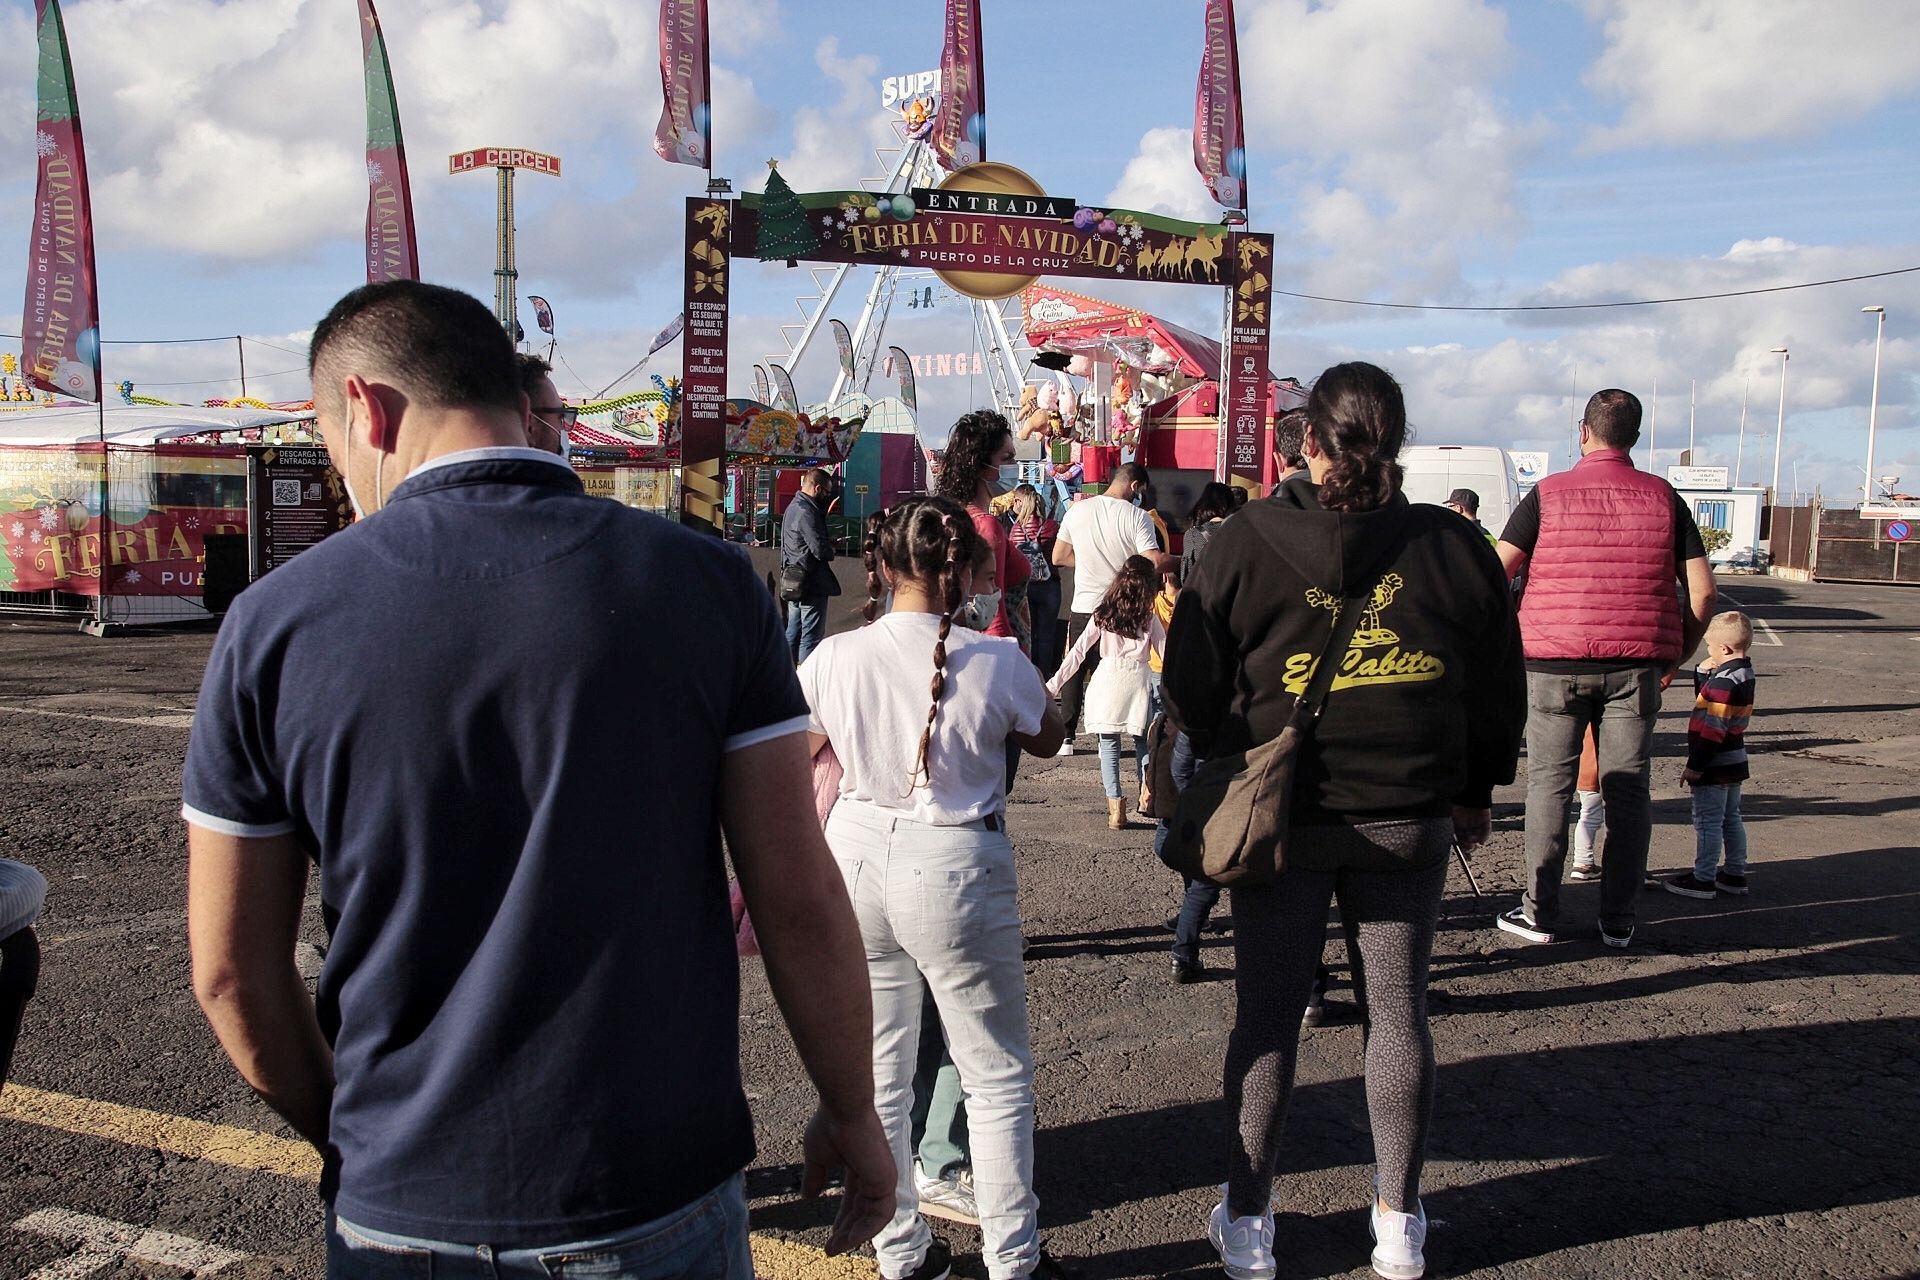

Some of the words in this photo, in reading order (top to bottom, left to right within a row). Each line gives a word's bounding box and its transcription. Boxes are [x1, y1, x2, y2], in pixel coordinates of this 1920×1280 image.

[451, 152, 475, 172] LA
[486, 149, 558, 174] CARCEL
[928, 194, 1057, 216] ENTRADA
[842, 221, 939, 255] FERIA
[949, 222, 987, 246] DE
[998, 224, 1124, 269] NAVIDAD
[919, 250, 977, 263] PUERTO
[983, 253, 1001, 265] DE
[1008, 255, 1026, 266] LA
[1032, 257, 1070, 269] CRUZ
[690, 302, 703, 311] ESTE
[703, 302, 726, 312] ESPACIO
[693, 310, 701, 319] ES
[701, 311, 722, 320] SEGURO
[690, 319, 704, 328] PARA
[705, 320, 716, 329] QUE
[717, 320, 724, 329] TE
[693, 328, 721, 337] DIVIERTAS
[1233, 327, 1244, 335] POR
[1244, 327, 1250, 335] LA
[1250, 328, 1266, 336] SALUD
[1233, 335, 1240, 343] DE
[703, 357, 711, 365] DE
[882, 352, 983, 378] VKINGA
[693, 385, 719, 394] ESPACIOS
[692, 402, 700, 410] DE
[700, 402, 719, 411] FORMA
[692, 410, 719, 419] CONTINUA
[279, 450, 317, 458] DESCARGA
[279, 458, 317, 466] ENTRADAS
[318, 458, 332, 466] AQU
[265, 468, 271, 477] 1
[588, 480, 597, 489] LA
[265, 511, 271, 520] 2
[265, 528, 272, 537] 3
[35, 522, 194, 581] FERIA
[265, 545, 272, 554] 4
[266, 560, 272, 569] 5
[1340, 646, 1444, 682] Cabito
